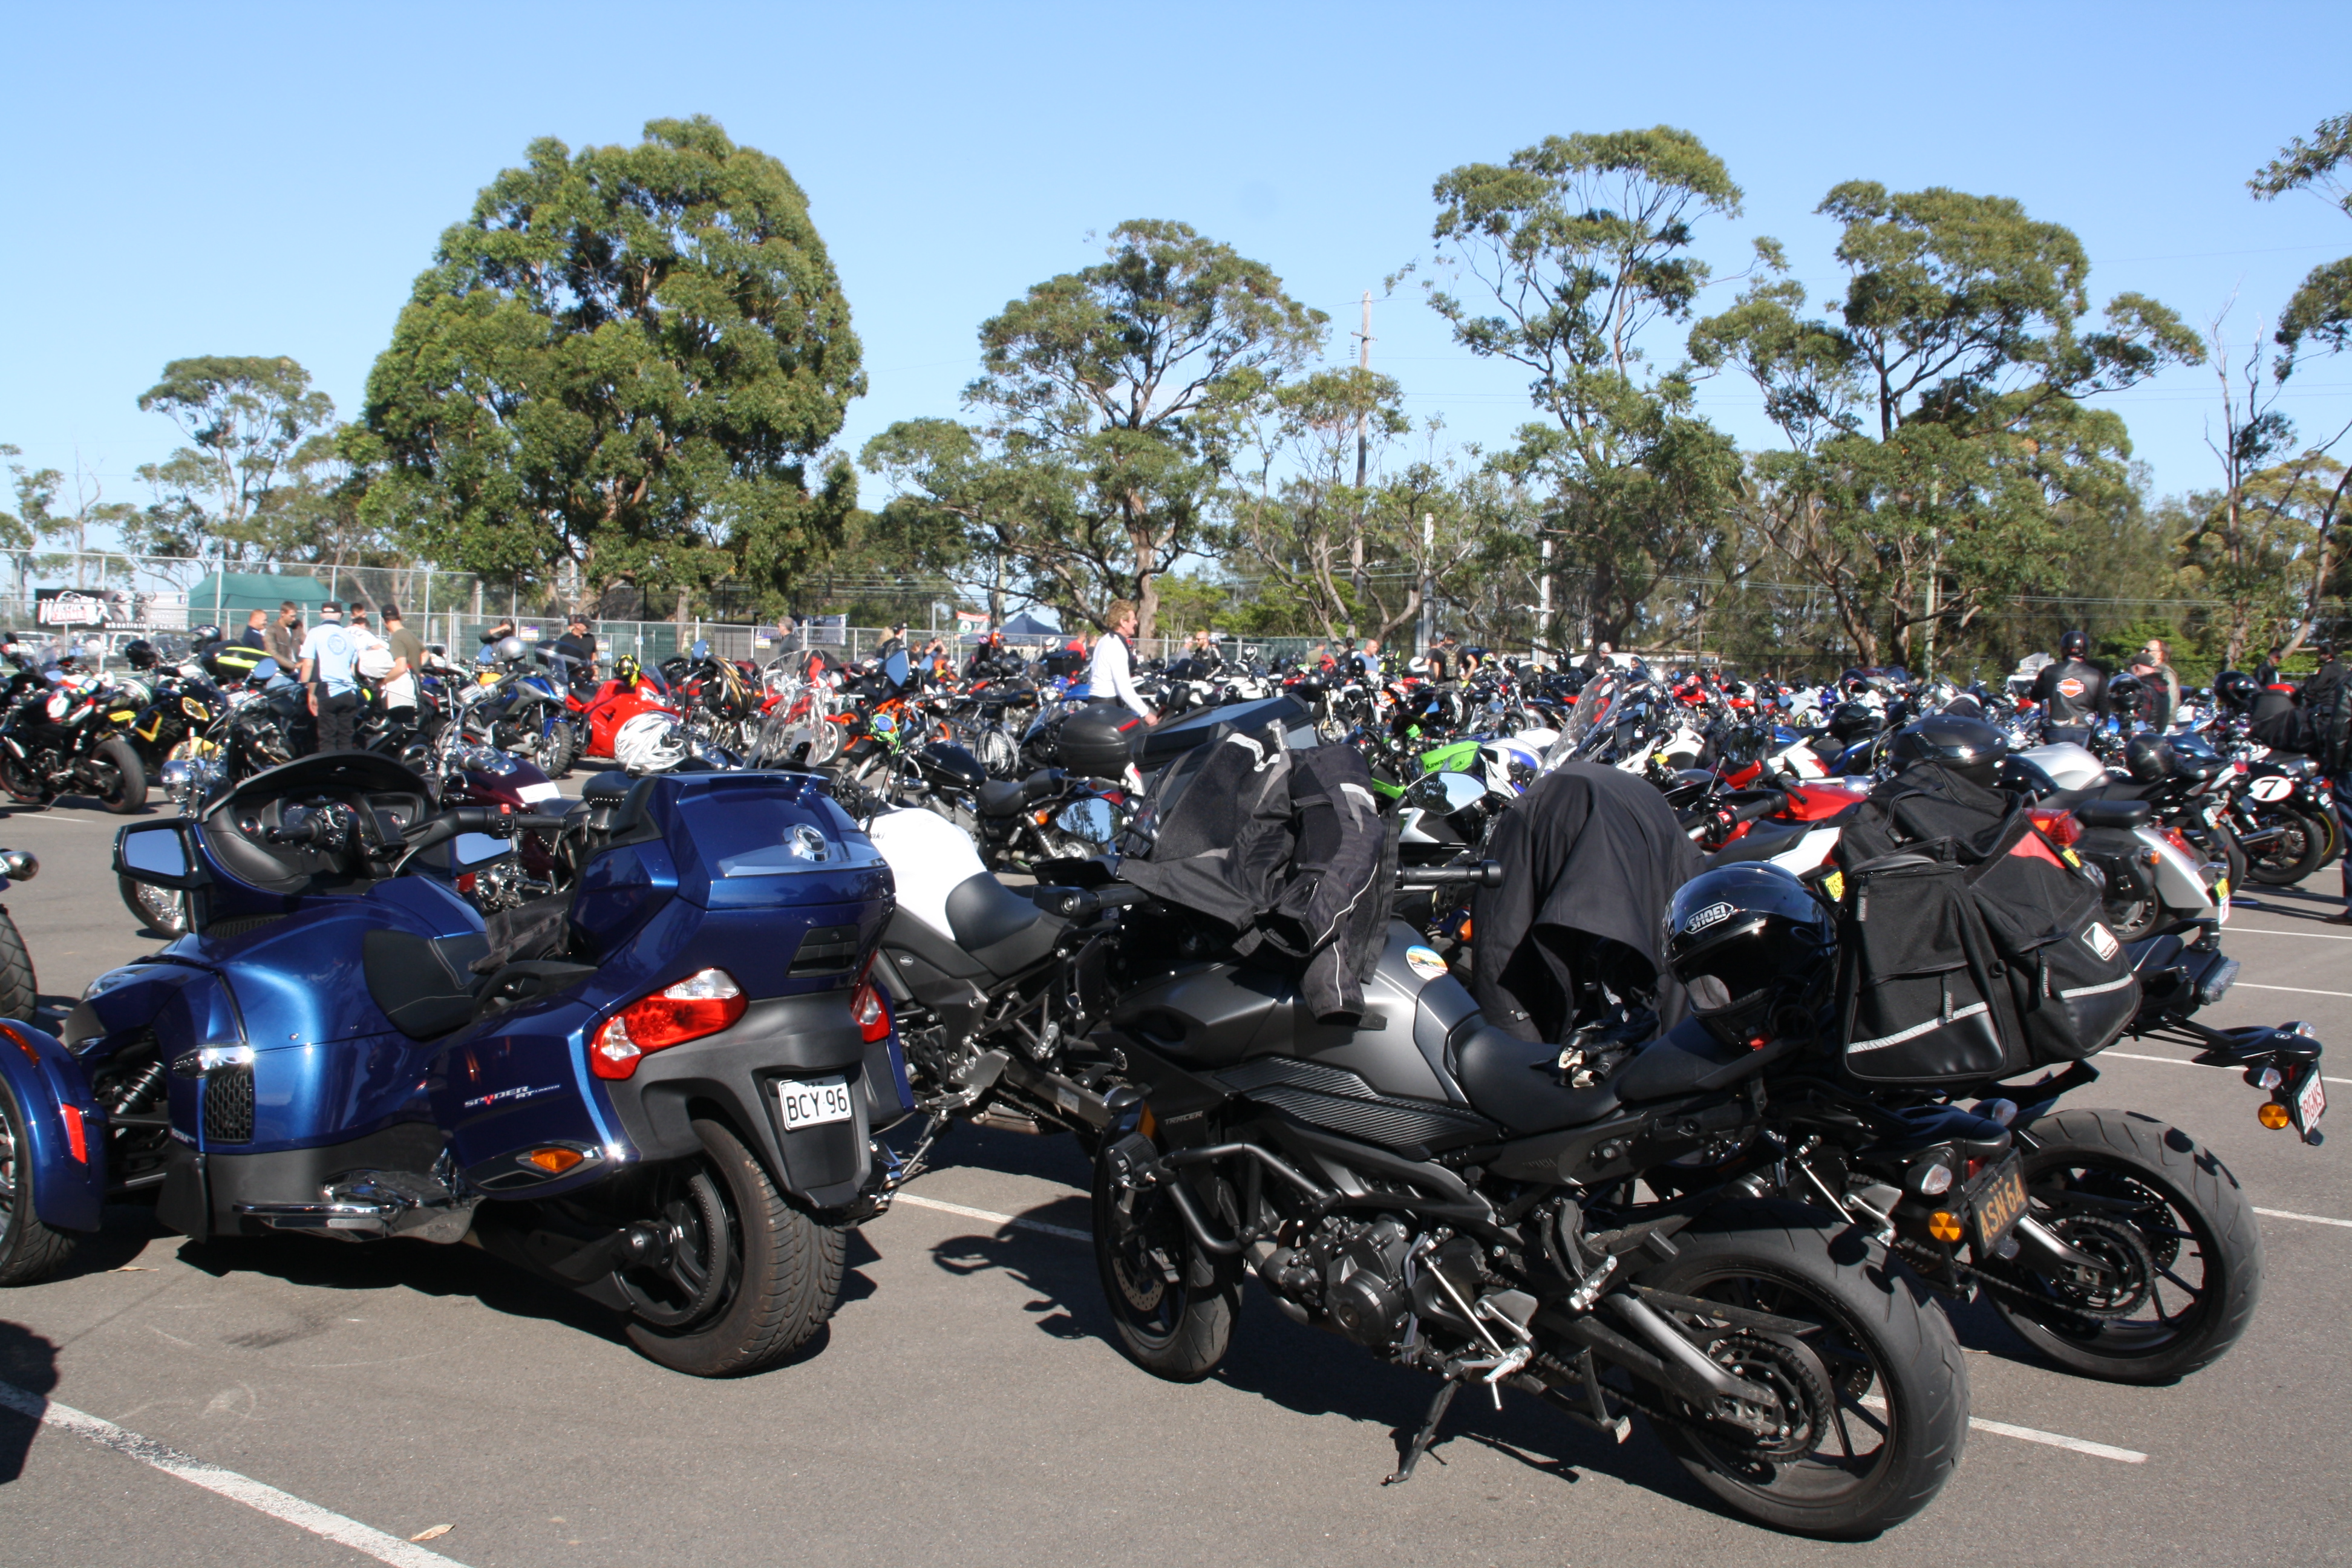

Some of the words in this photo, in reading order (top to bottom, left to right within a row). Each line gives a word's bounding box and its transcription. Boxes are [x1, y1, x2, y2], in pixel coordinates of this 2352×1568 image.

[2259, 779, 2281, 799] 7
[1689, 904, 1726, 932] SHOEI
[465, 1086, 529, 1108] SPYDER
[515, 1090, 534, 1099] RT
[1165, 1110, 1203, 1125] TRACER
